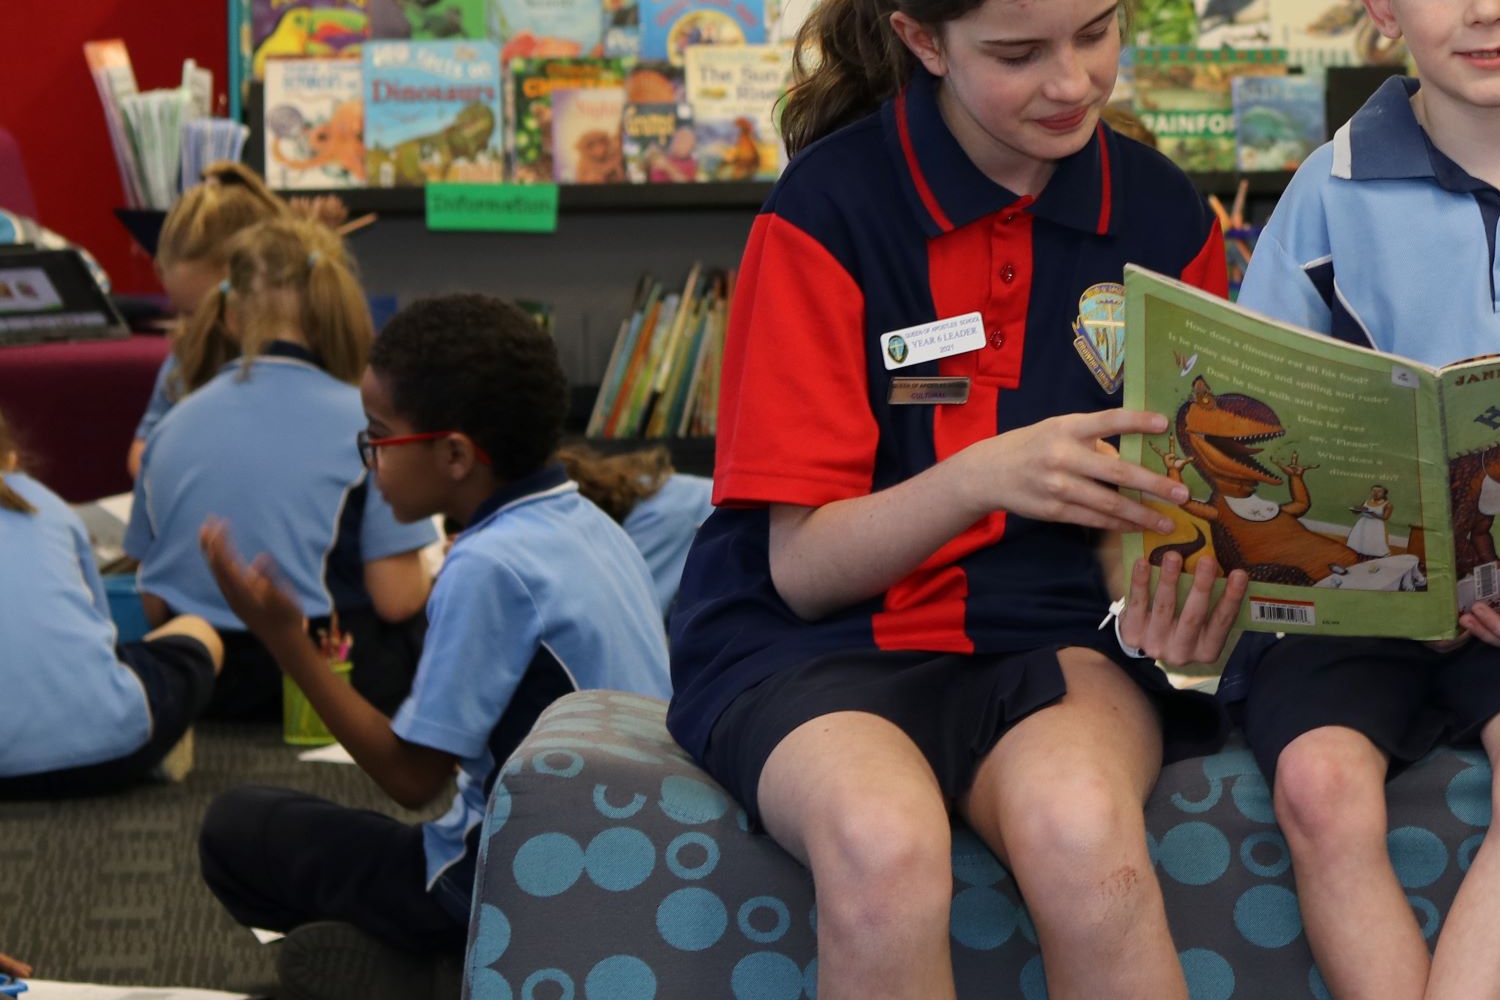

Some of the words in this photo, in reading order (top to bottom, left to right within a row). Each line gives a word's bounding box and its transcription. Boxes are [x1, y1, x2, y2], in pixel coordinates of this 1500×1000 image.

[700, 66, 736, 84] The
[371, 79, 496, 105] Dinosaurs
[911, 333, 937, 349] YEAR
[943, 326, 978, 343] LEADER
[939, 343, 955, 354] 2021
[1184, 318, 1207, 335] How
[1209, 330, 1231, 344] does
[1241, 342, 1285, 365] dinosaur
[1287, 357, 1304, 370] eat
[1305, 362, 1319, 374] all
[1321, 366, 1338, 380] his
[1339, 370, 1370, 386] food?
[1167, 331, 1178, 342] Is
[1178, 335, 1191, 347] he
[1193, 343, 1219, 362] noisy
[1220, 351, 1240, 367] and
[1240, 359, 1272, 380] jumpy
[1274, 372, 1294, 386] and
[1295, 376, 1333, 397] spilling
[1335, 388, 1355, 401] and
[1357, 393, 1390, 406] rude?
[1206, 365, 1229, 382] Does
[1232, 376, 1246, 389] he
[1246, 381, 1266, 395] toss
[1268, 386, 1292, 402] milk
[1293, 394, 1314, 408] and
[1315, 401, 1346, 416] peas?
[1297, 414, 1323, 429] Does
[1325, 420, 1340, 431] he
[1341, 424, 1367, 434] ever
[1308, 433, 1328, 446] say,
[1316, 450, 1346, 464] What
[1347, 454, 1374, 466] does
[1328, 467, 1376, 481] dinosaur
[1378, 472, 1400, 483] do?
